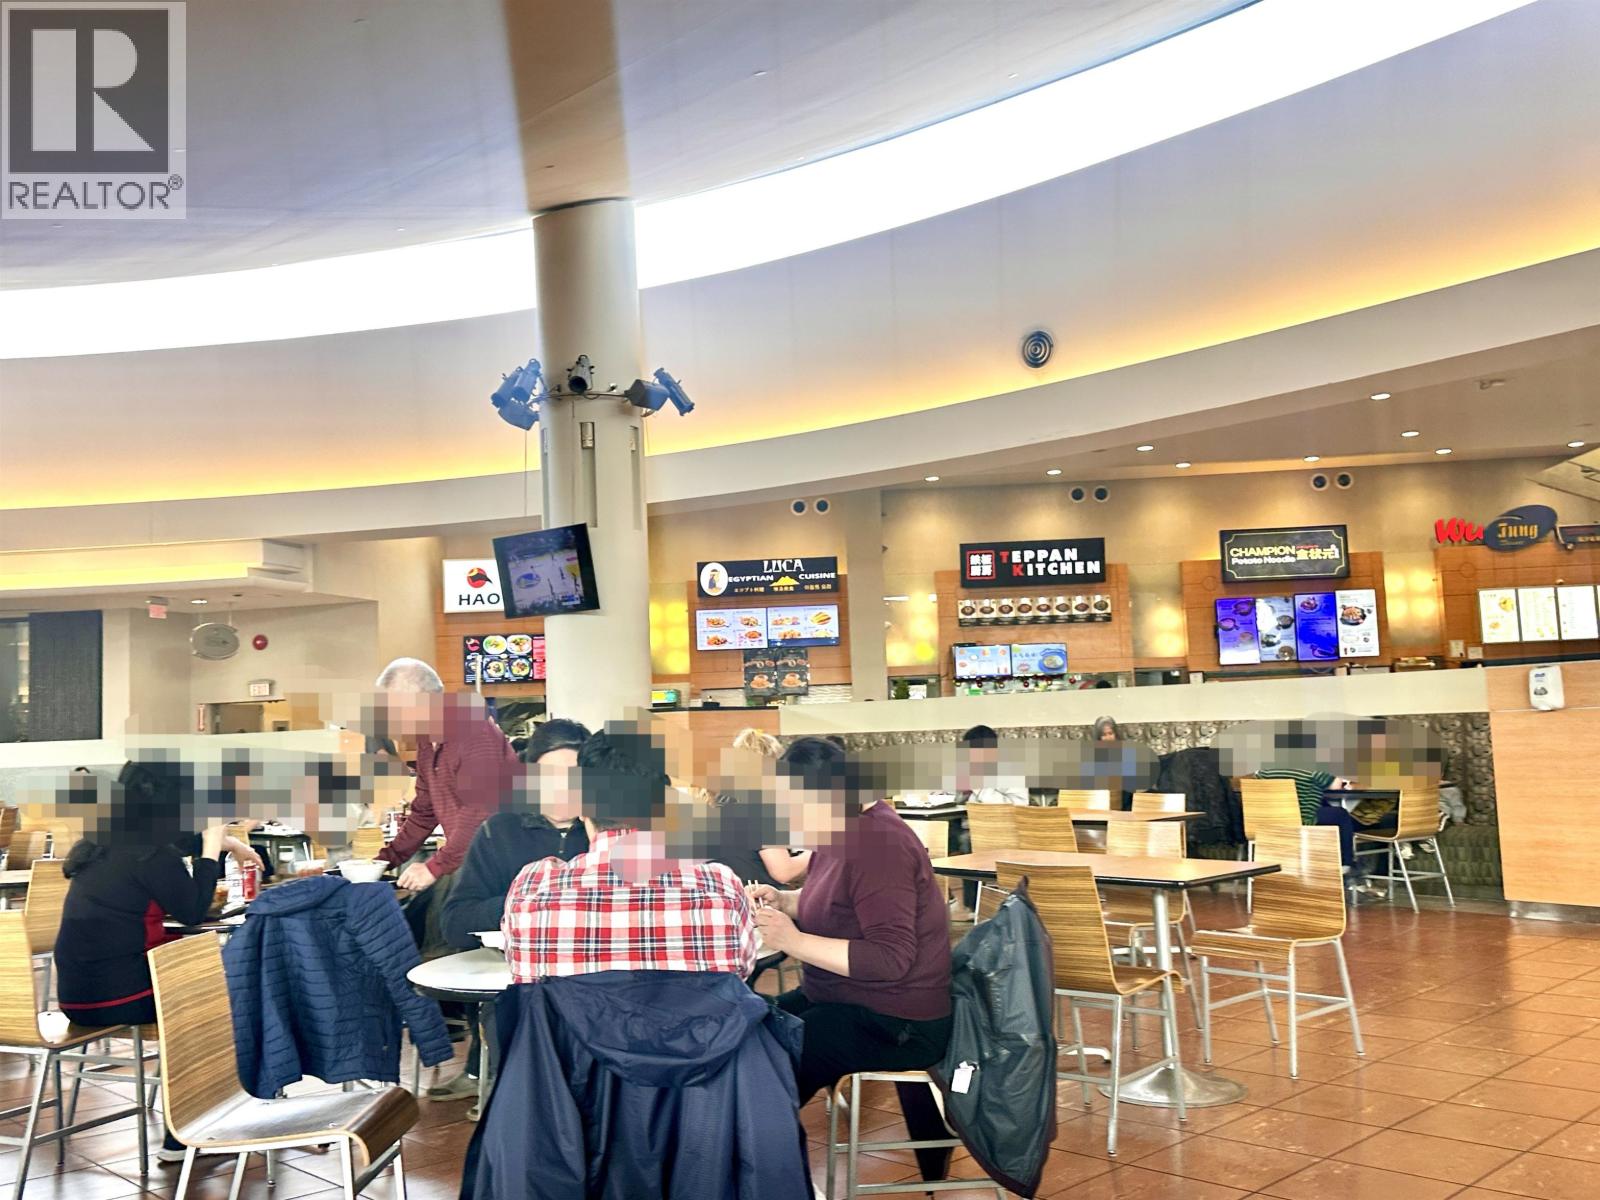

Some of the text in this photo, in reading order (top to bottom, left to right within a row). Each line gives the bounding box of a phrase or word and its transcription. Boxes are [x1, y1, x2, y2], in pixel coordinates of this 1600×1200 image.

[1000, 548, 1078, 563] TEPPAN
[1229, 545, 1296, 557] CHAMPION
[763, 559, 805, 573] LUCA
[1231, 555, 1297, 565] Potato Noodle
[1012, 560, 1101, 577] KITCHEN
[728, 572, 836, 583] EGYPTIAN CUISINE
[458, 593, 501, 606] HAO
